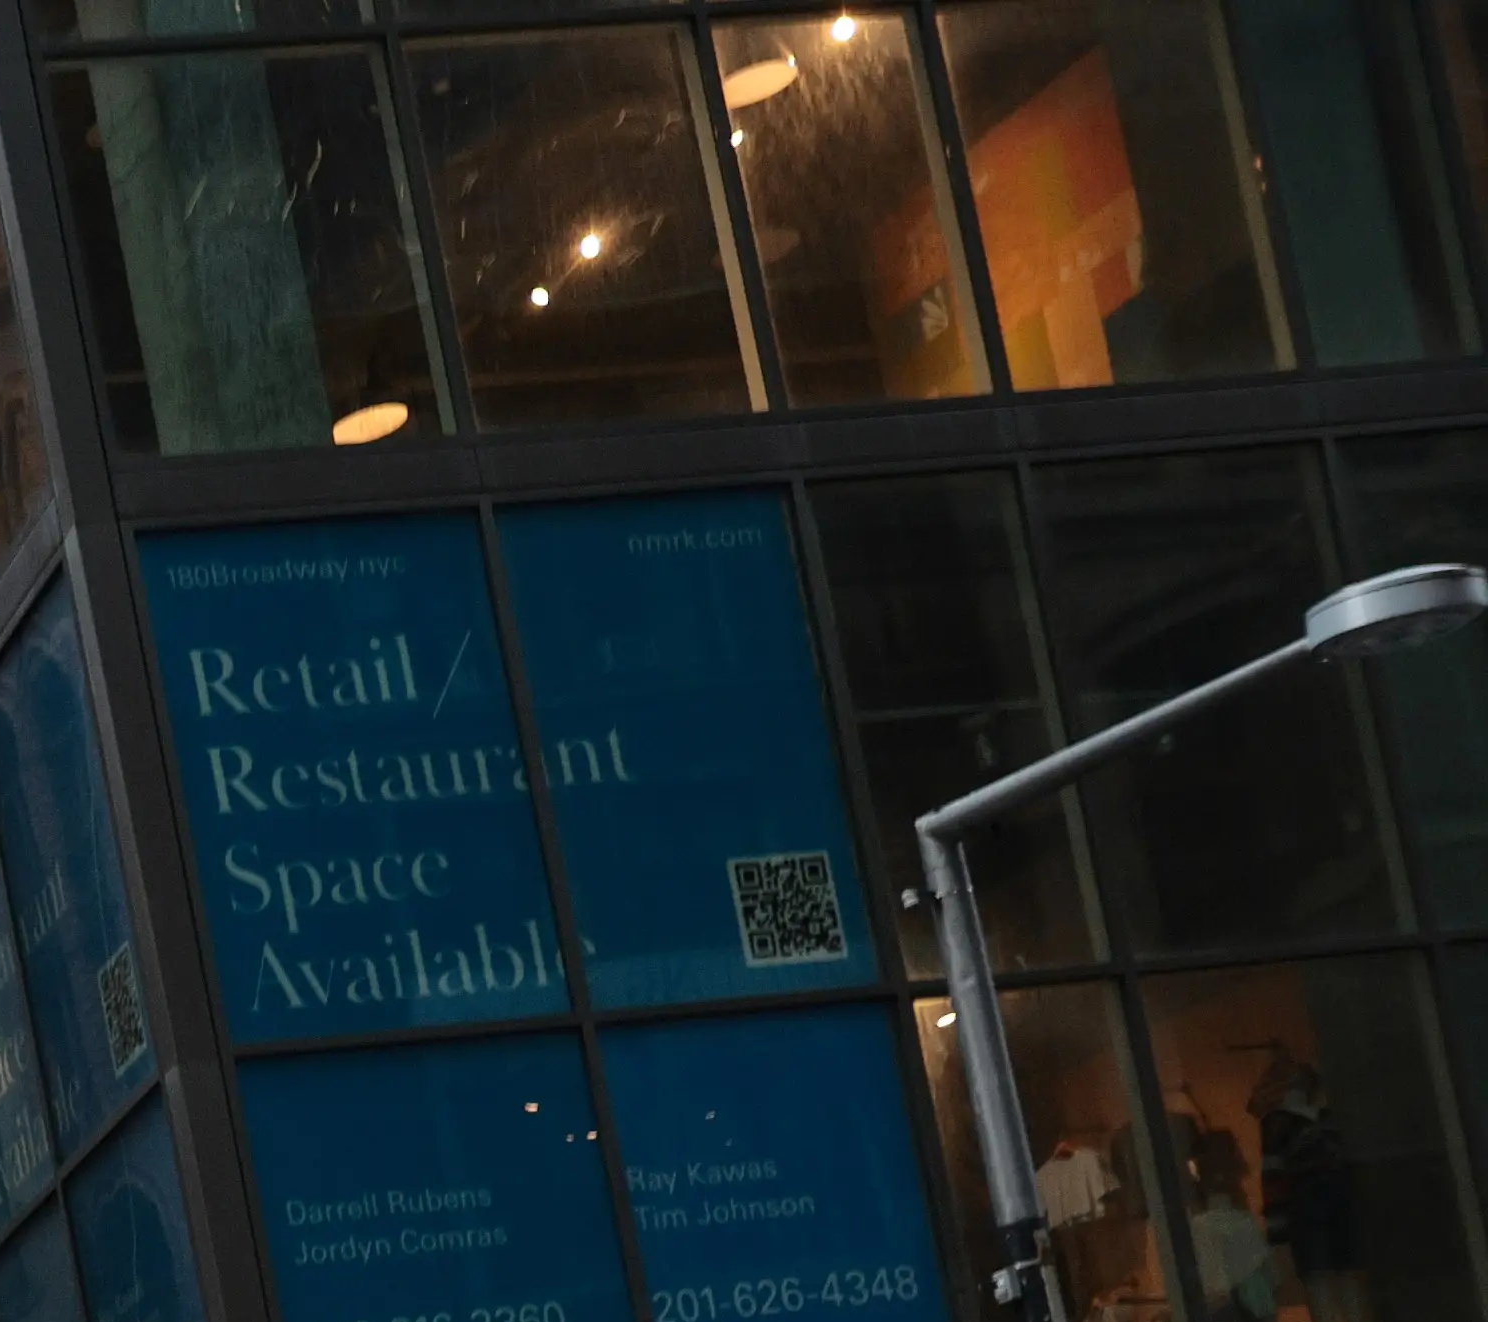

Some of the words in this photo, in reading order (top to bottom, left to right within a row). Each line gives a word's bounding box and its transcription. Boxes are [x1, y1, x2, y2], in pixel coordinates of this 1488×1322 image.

[627, 525, 764, 555] nmrk.com
[188, 632, 419, 718] Retail
[206, 724, 634, 815] Restaurant
[224, 840, 449, 935] Space
[626, 1165, 676, 1196] Ray
[686, 1158, 779, 1187] Kawas
[285, 1192, 379, 1228] Darrell
[387, 1187, 493, 1217] Rubens
[634, 1204, 688, 1232] Tim
[697, 1195, 816, 1227] Johnson
[294, 1236, 392, 1267] Jordyn
